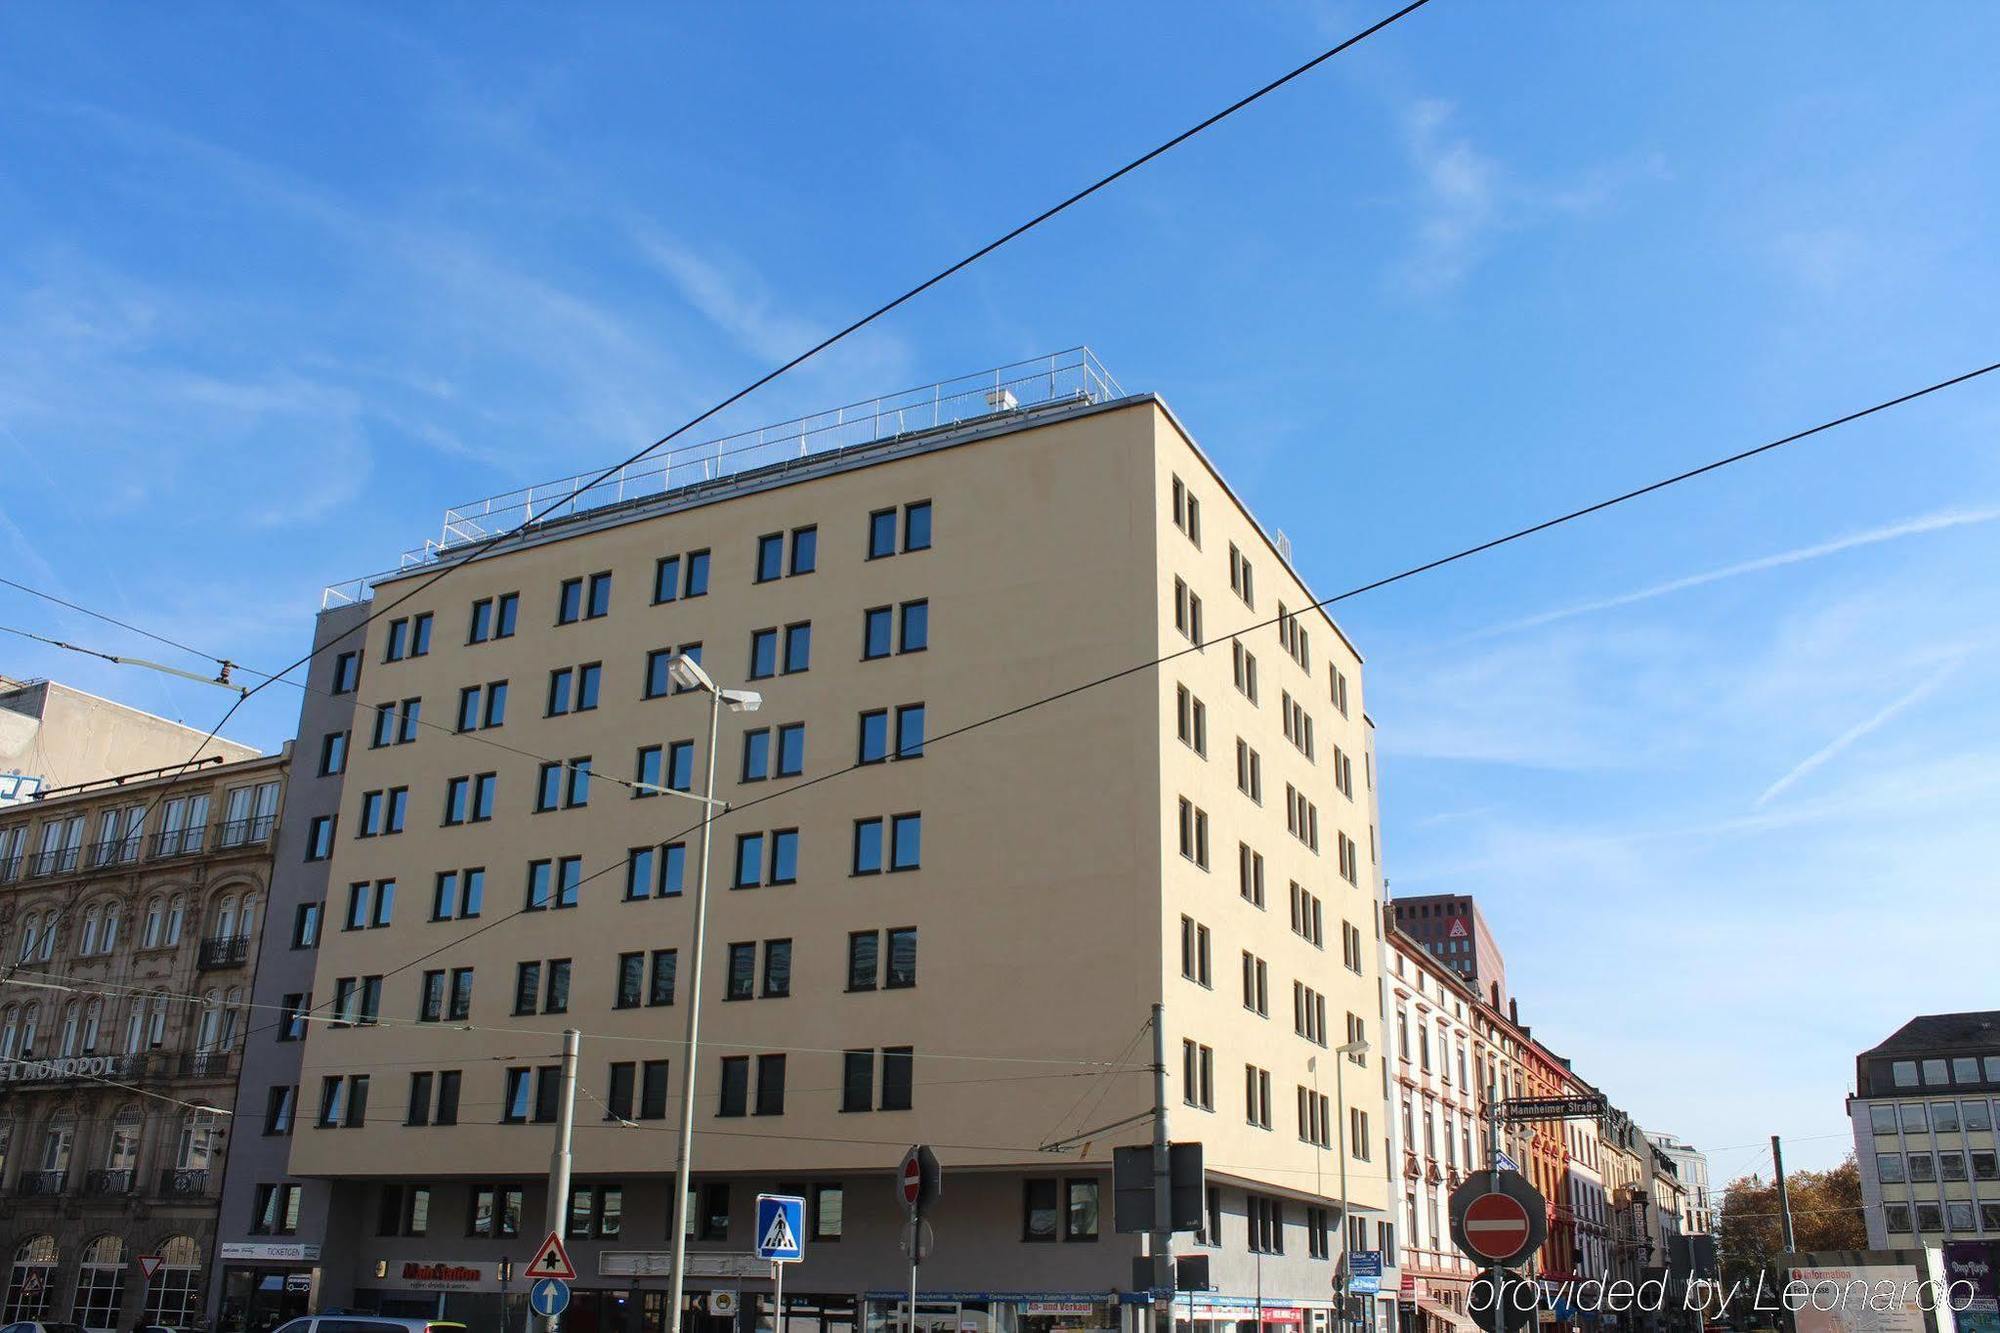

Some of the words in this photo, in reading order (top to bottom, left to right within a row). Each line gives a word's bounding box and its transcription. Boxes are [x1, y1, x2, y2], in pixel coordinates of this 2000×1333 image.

[22, 1057, 114, 1080] MONOPOL
[1511, 1104, 1564, 1116] Mannheimer
[1568, 1102, 1597, 1113] Straße
